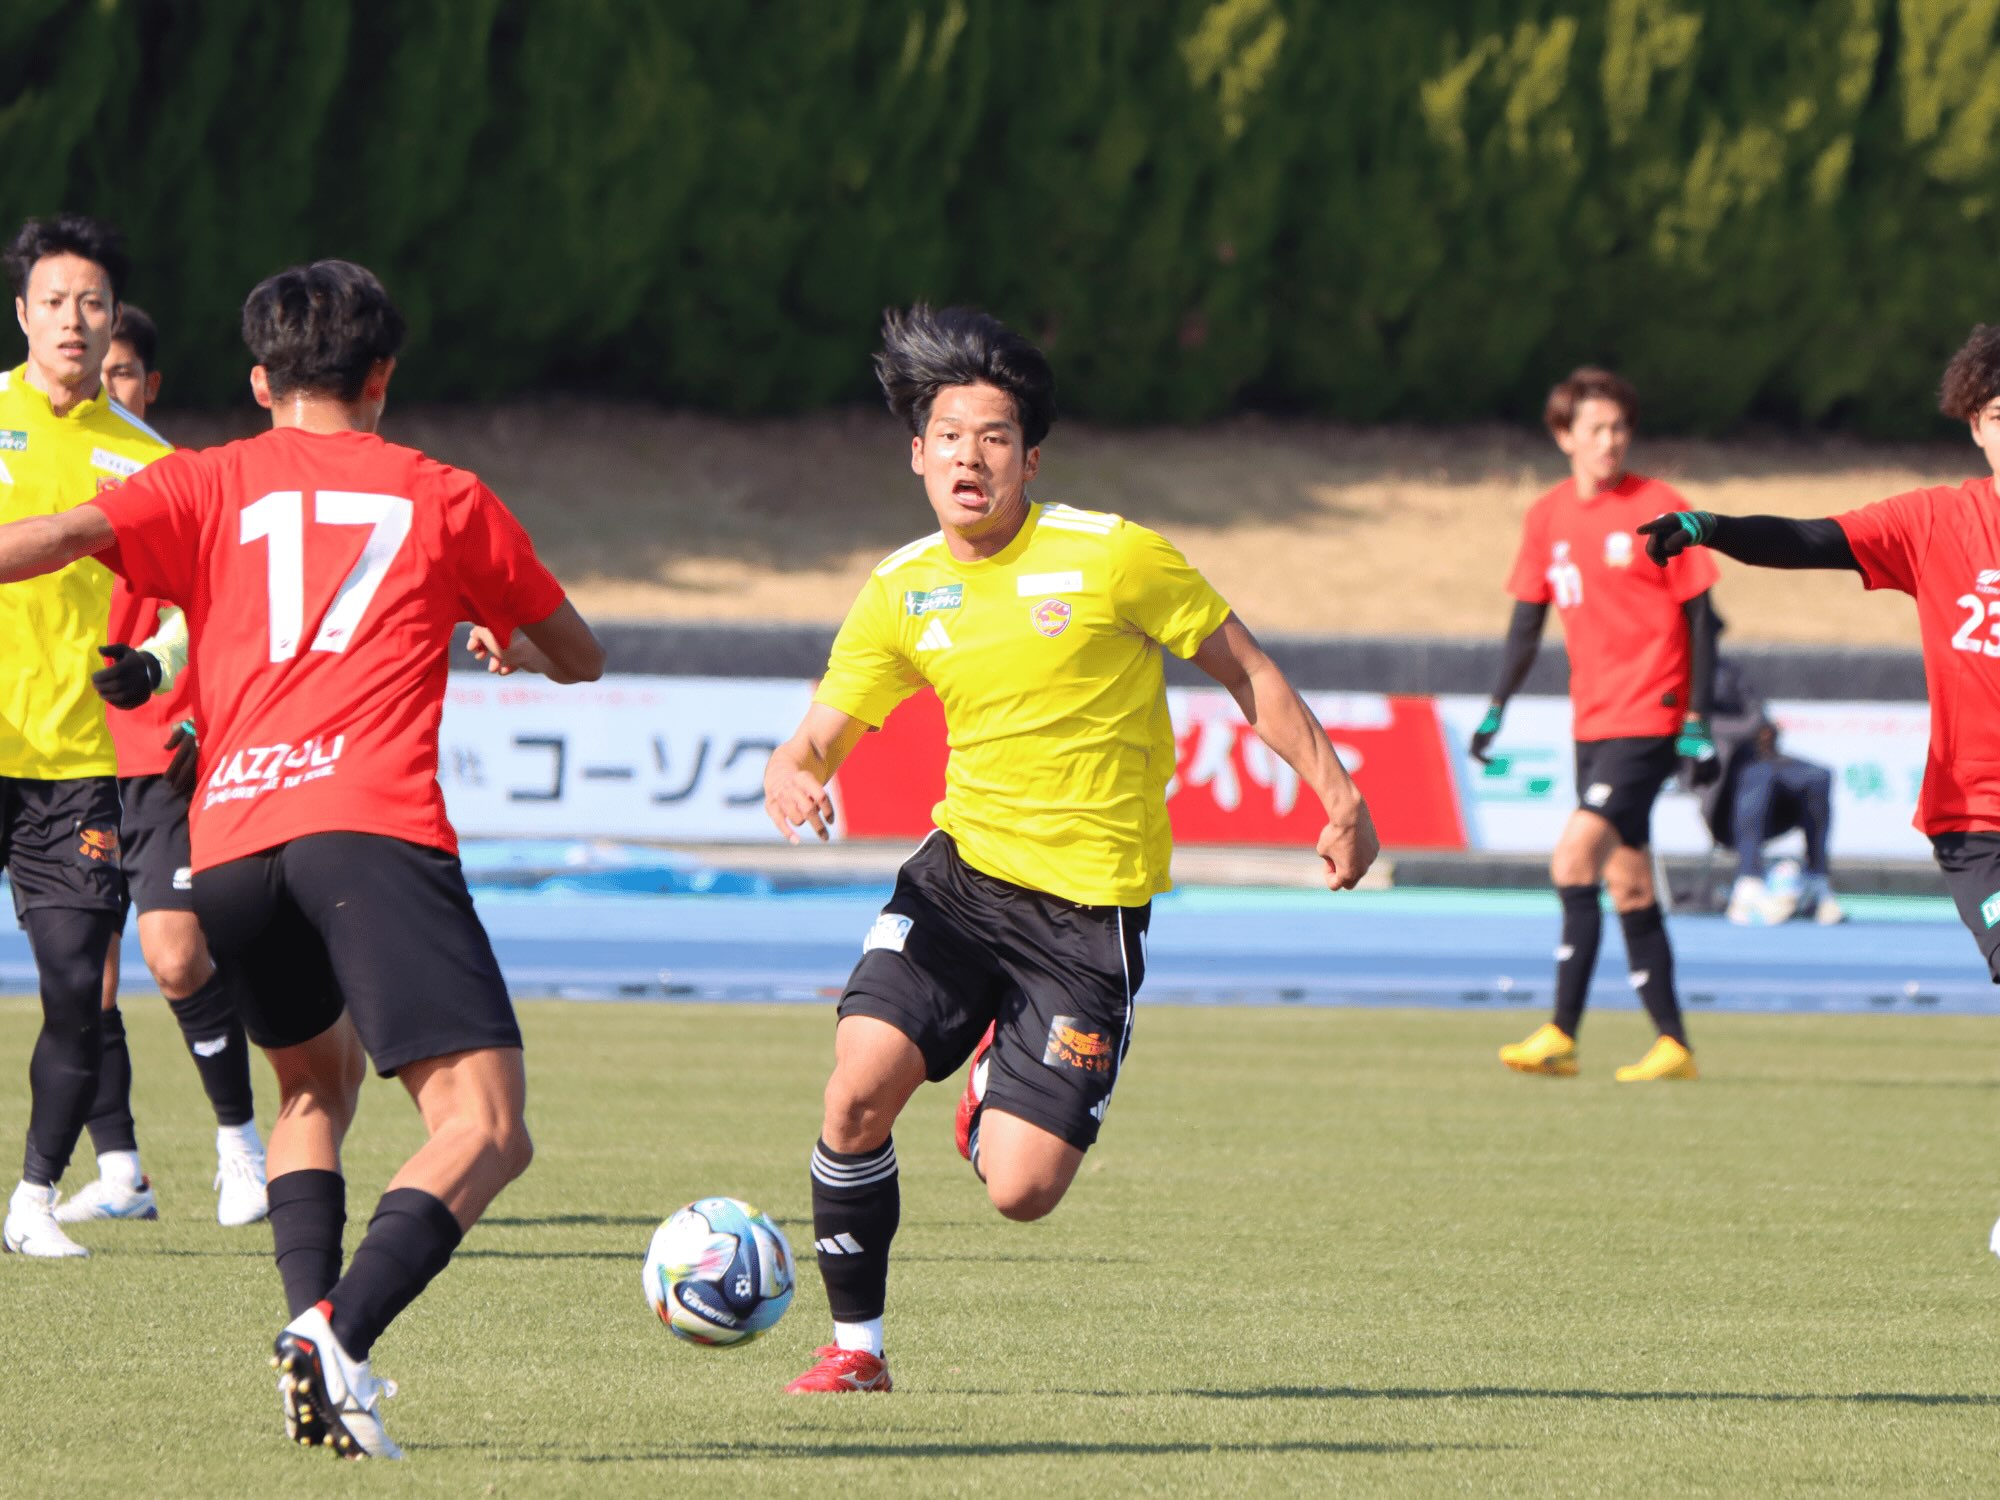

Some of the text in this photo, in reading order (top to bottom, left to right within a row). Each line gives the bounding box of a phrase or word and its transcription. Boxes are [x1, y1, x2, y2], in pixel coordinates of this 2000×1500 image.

[240, 490, 414, 663] 17
[1951, 593, 2000, 658] 23
[507, 735, 778, 807] コーソク
[683, 1288, 737, 1328] TSUBASA
